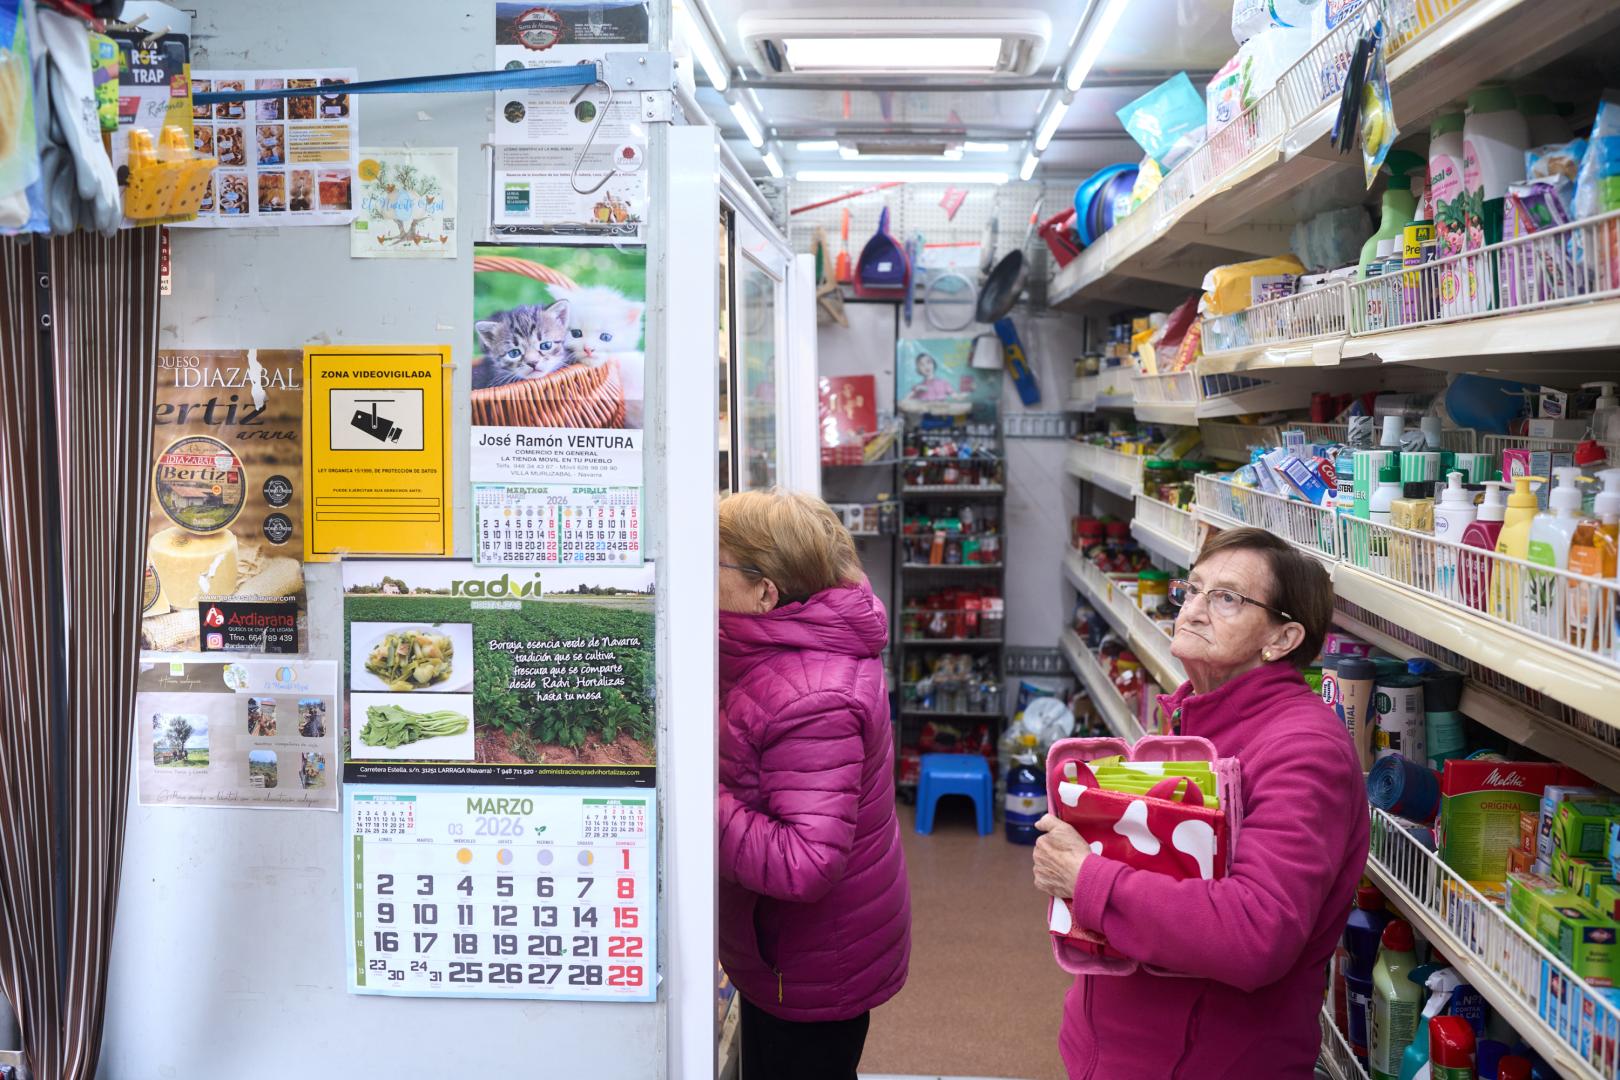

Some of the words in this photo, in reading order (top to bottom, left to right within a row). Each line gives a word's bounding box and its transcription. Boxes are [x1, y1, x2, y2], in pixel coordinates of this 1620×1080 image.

[132, 68, 164, 83] TRAP
[158, 356, 200, 369] QUESO
[175, 368, 300, 388] IDIAZABAL
[353, 370, 432, 378] VIDEOVIGILADA
[154, 394, 266, 426] ertiz
[236, 430, 297, 440] arana
[479, 434, 511, 446] José
[516, 434, 562, 447] Ramón
[568, 436, 634, 448] VENTURA
[166, 455, 214, 465] IDIAZABAL
[164, 467, 226, 480] Bertiz
[546, 496, 568, 504] 2026
[563, 542, 573, 550] 20
[575, 542, 583, 550] 21
[585, 542, 595, 550] 22
[596, 542, 606, 550] 23
[607, 542, 617, 550] 24
[618, 542, 628, 550] 25
[629, 542, 639, 550] 26
[452, 572, 541, 597] radvi
[228, 611, 294, 627] Ardiarana
[229, 633, 247, 641] Tfno.
[527, 639, 560, 648] esencia
[562, 637, 585, 648] verde
[588, 637, 599, 647] de
[515, 652, 552, 662] tradición
[554, 654, 570, 664] que
[514, 666, 548, 676] frescura
[550, 667, 566, 678] que
[581, 664, 623, 676] comparte
[509, 679, 536, 689] desde
[542, 677, 570, 688] Radvi
[576, 676, 625, 688] Hortalizas
[537, 691, 562, 701] hasta
[564, 692, 575, 700] tu
[577, 692, 601, 700] mesa
[1346, 704, 1355, 737] STRIAL
[1482, 768, 1524, 786] Melitta
[466, 797, 533, 815] MARZO
[448, 824, 463, 835] 03
[475, 817, 524, 837] 2026
[622, 849, 629, 870] 1
[378, 874, 394, 895] 2
[417, 875, 433, 895] 3
[457, 876, 473, 896] 4
[497, 876, 514, 897] 5
[537, 877, 554, 897] 6
[577, 877, 594, 898] 7
[618, 878, 634, 899] 8
[378, 903, 394, 923] 9
[413, 904, 438, 924] 10
[457, 904, 473, 925] 11
[493, 905, 518, 926] 12
[533, 906, 558, 927] 13
[573, 907, 598, 927] 14
[613, 907, 638, 928] 15
[374, 931, 398, 952] 16
[413, 932, 438, 953] 17
[453, 934, 477, 954] 18
[493, 934, 518, 955] 19
[528, 935, 562, 956] 20
[572, 936, 598, 957] 21
[608, 936, 643, 957] 22
[370, 960, 386, 970] 23
[411, 961, 427, 971] 24
[449, 962, 483, 982] 25
[488, 963, 522, 983] 26
[528, 964, 562, 984] 27
[568, 965, 602, 985] 28
[608, 966, 643, 986] 29
[388, 970, 404, 980] 30
[430, 971, 442, 982] 31
